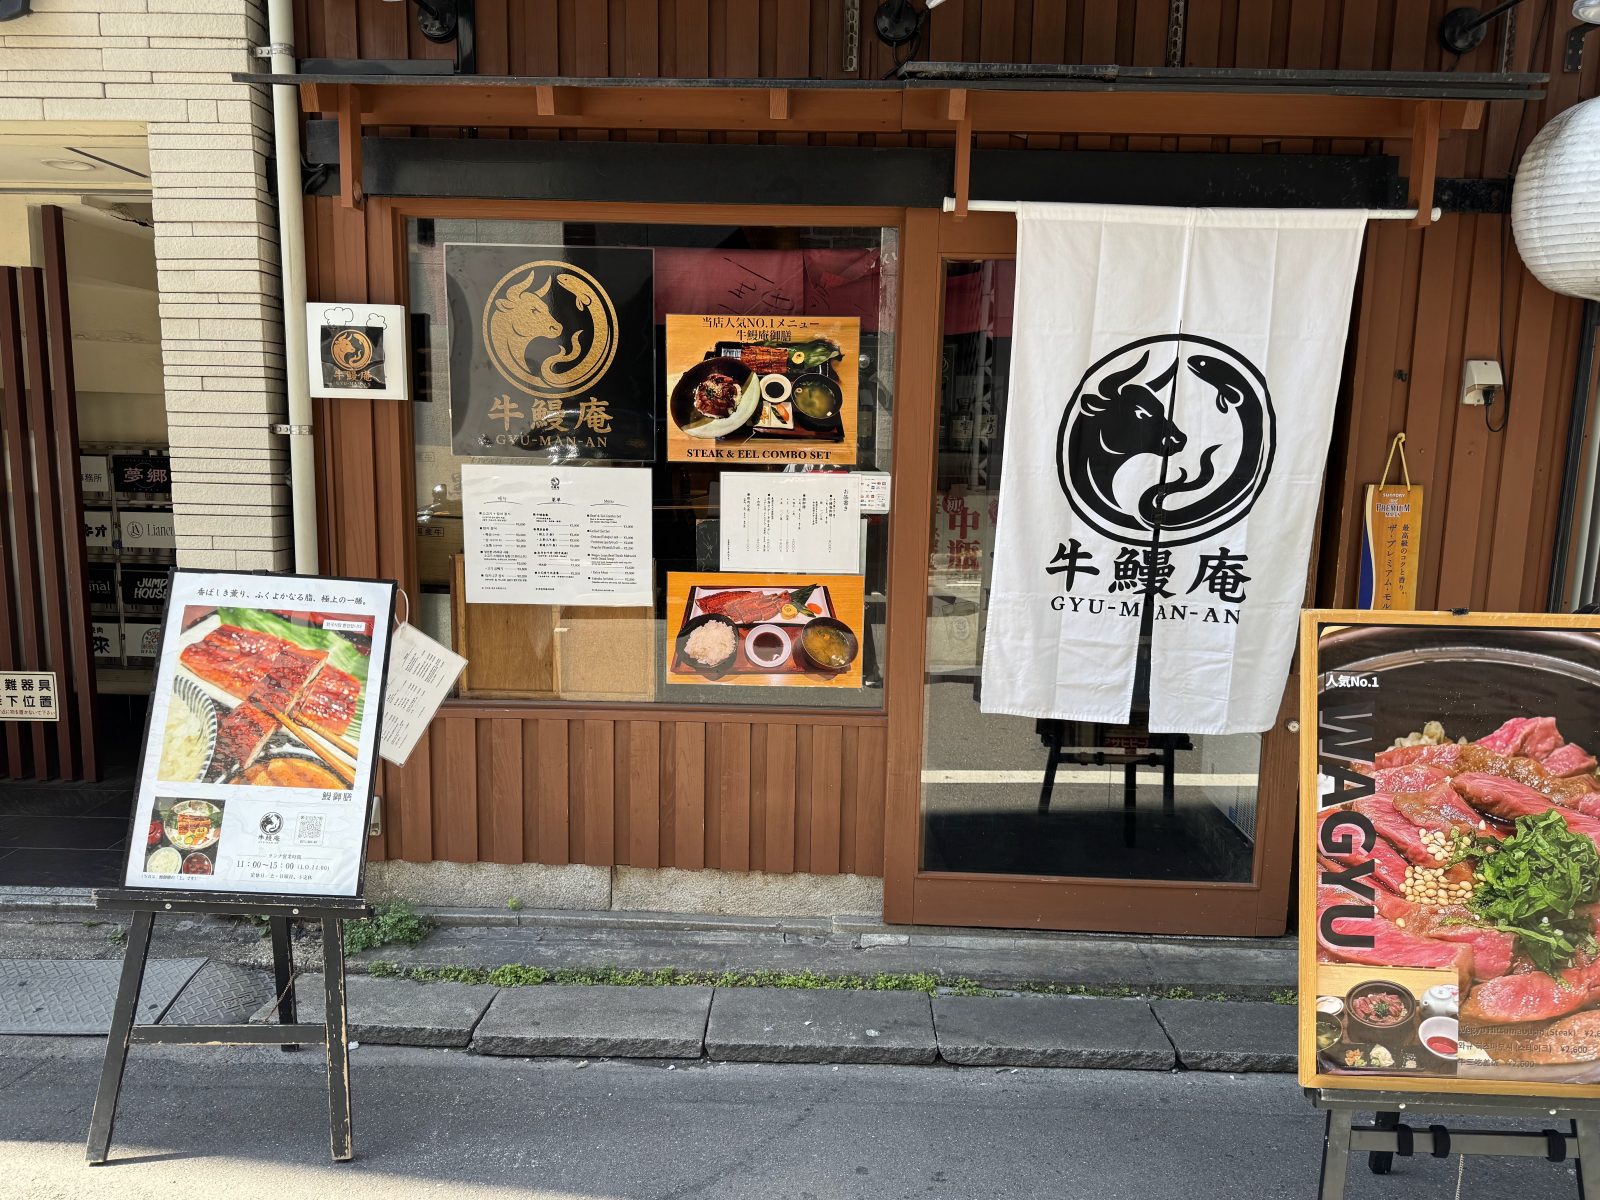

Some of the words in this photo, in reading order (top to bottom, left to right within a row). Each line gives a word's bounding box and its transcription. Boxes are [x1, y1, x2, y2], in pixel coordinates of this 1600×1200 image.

[702, 317, 820, 330] 当店人気NO.1メニュー
[736, 330, 792, 342] 牛鰻庵御膳
[487, 394, 614, 434] 牛鰻庵
[496, 433, 608, 448] GYU-MAN-AN
[686, 449, 724, 459] STEAK
[727, 450, 735, 459] &
[738, 450, 760, 459] EEL
[762, 450, 807, 460] COMBO
[809, 451, 832, 460] SET
[123, 468, 168, 484] 夢郷
[1376, 503, 1411, 512] PREMIUM
[1045, 538, 1252, 604] 牛鰻庵
[1050, 595, 1241, 624] GYU-MAN-AN
[0, 678, 52, 692] 難器具
[1325, 674, 1380, 688] 人気No.1
[0, 694, 53, 708] 下位置
[1319, 702, 1377, 950] WAGYU
[1546, 1029, 1576, 1037] (Steak)
[1560, 1045, 1588, 1054] ¥2,600
